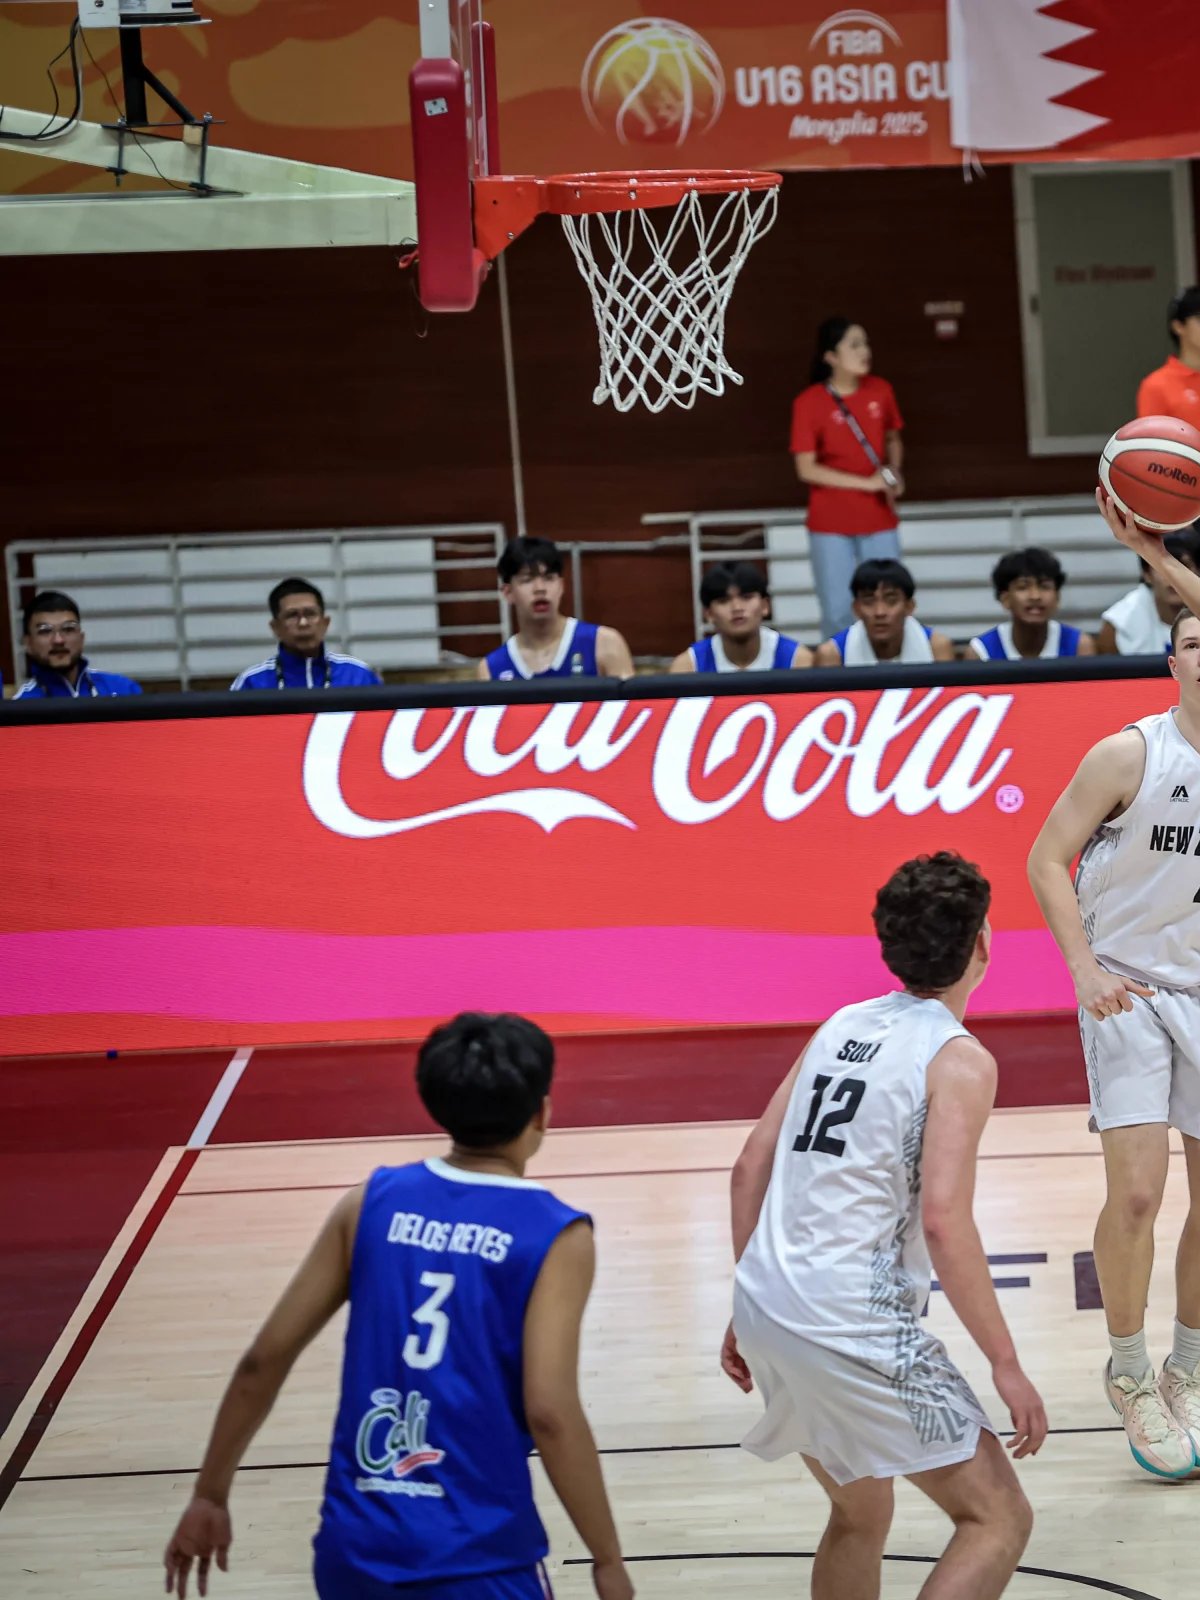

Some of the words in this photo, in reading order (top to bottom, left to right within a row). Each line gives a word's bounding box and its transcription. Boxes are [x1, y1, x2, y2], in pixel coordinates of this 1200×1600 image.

[827, 29, 883, 56] FIBA
[735, 64, 803, 106] U16
[811, 63, 897, 103] ASIA
[1147, 462, 1198, 487] molten
[1150, 825, 1194, 854] NEW
[792, 1073, 867, 1158] 12
[386, 1211, 450, 1253] DELOS
[447, 1222, 513, 1264] REYES
[402, 1270, 456, 1371] 3
